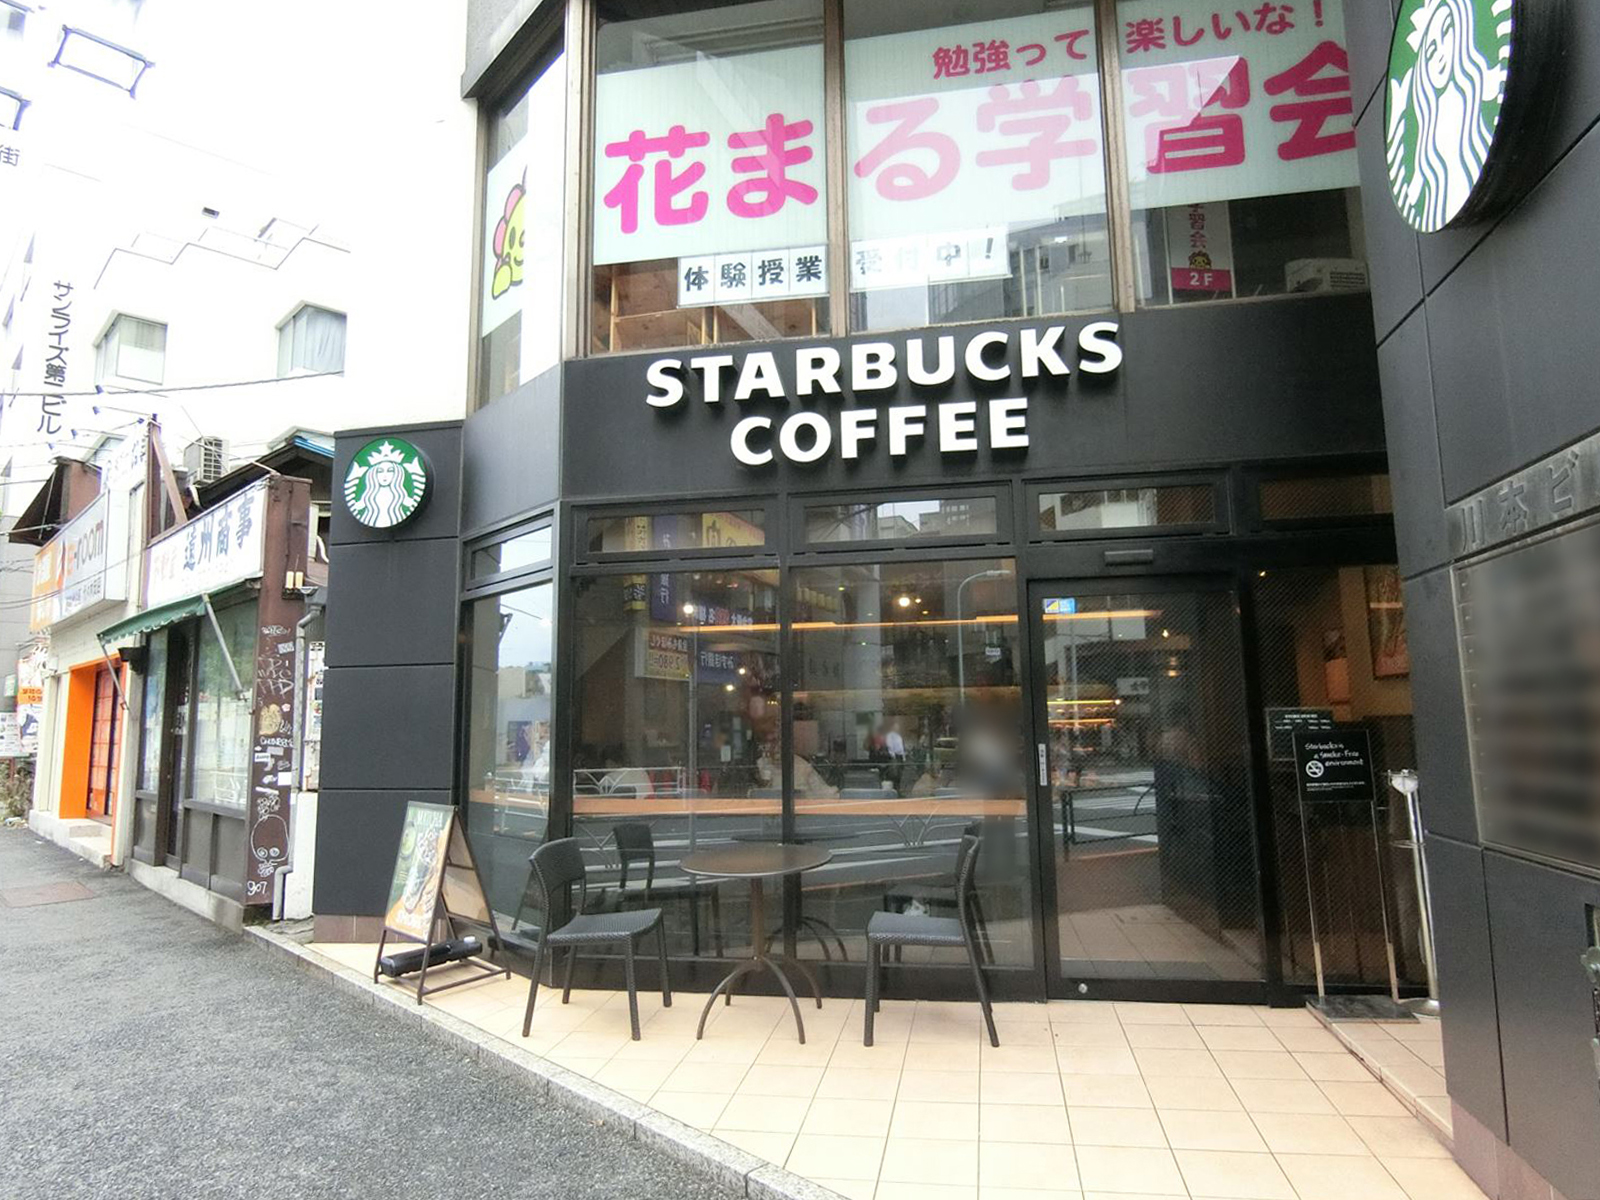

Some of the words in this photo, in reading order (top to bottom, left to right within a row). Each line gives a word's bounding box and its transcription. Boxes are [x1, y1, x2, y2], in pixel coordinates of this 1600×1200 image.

[933, 29, 1089, 80] 勉強って
[646, 321, 1123, 408] STARBUCKS
[729, 397, 1030, 466] COFFEE
